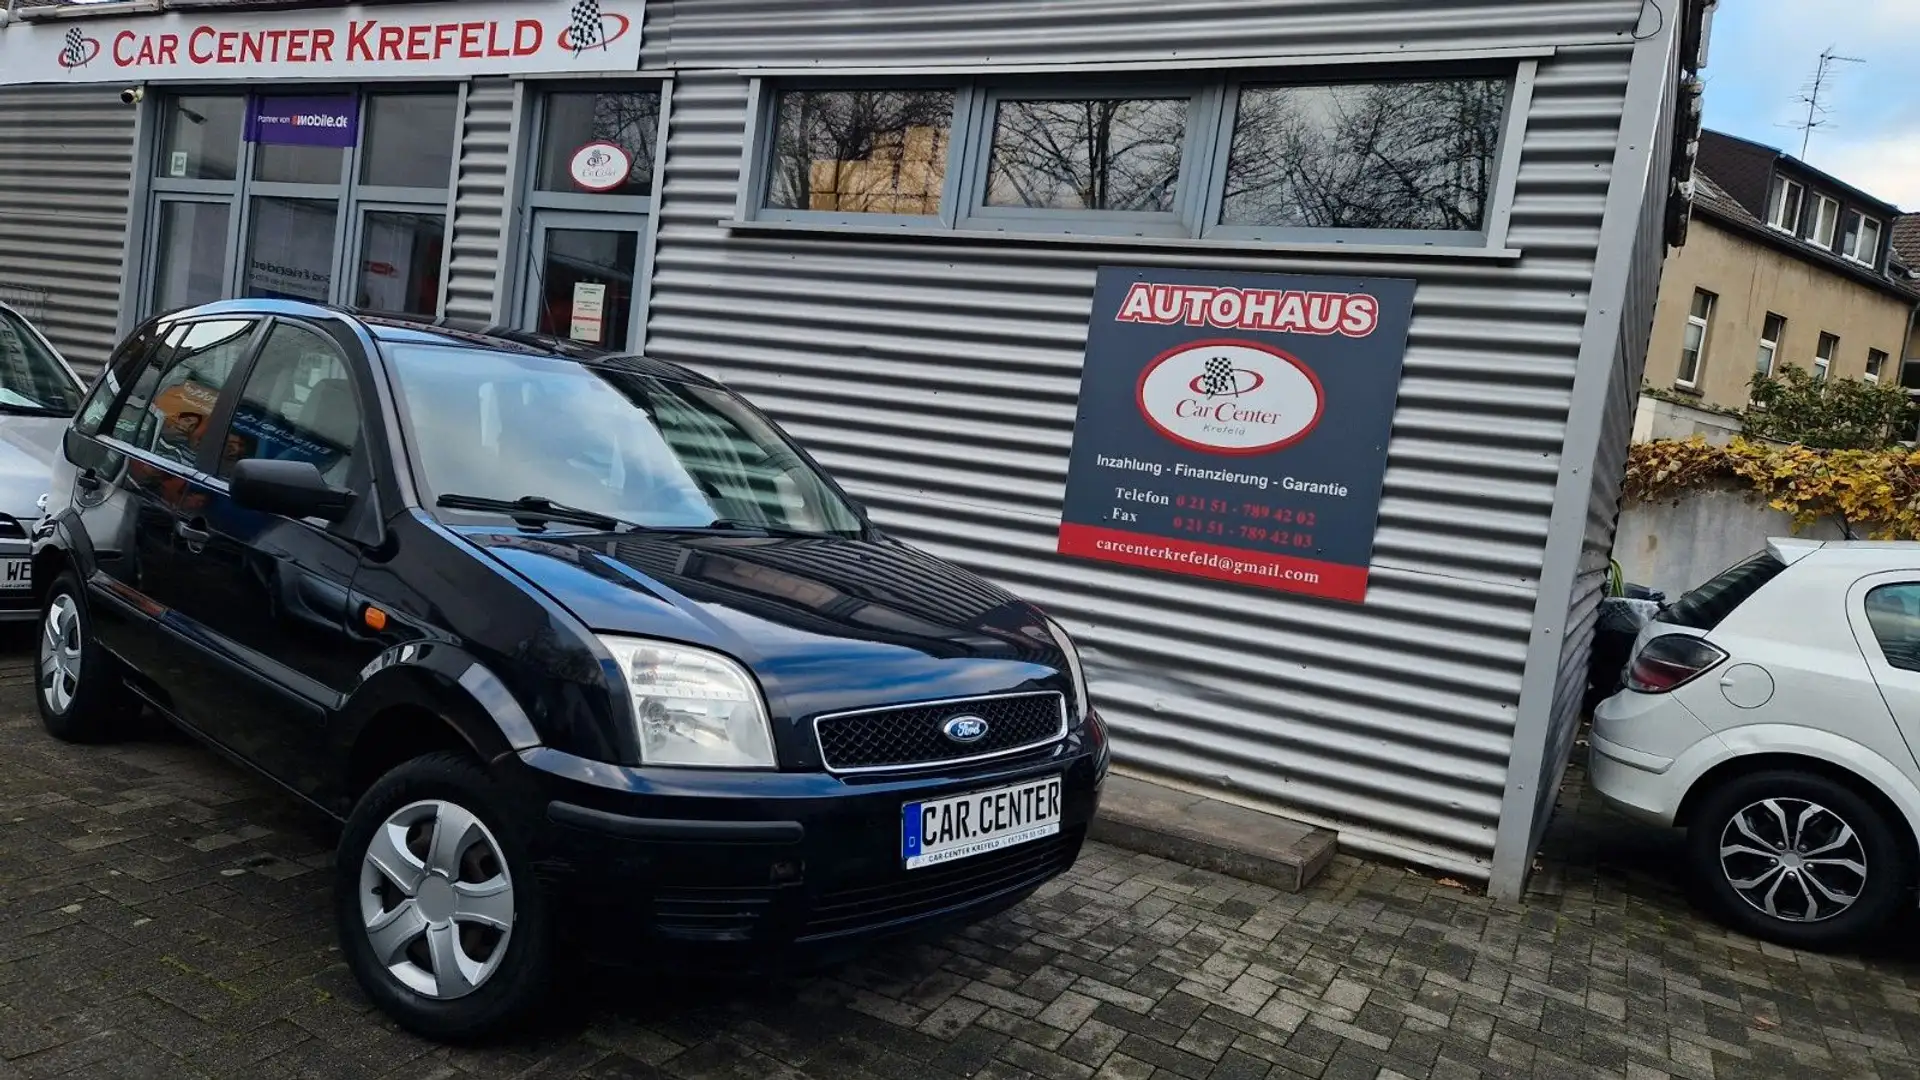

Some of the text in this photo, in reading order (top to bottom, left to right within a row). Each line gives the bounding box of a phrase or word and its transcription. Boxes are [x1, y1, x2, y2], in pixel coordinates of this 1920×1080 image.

[113, 19, 543, 67] CAR CENTER KREFELD
[1115, 282, 1379, 338] AUTOHAUS
[1175, 398, 1282, 424] Car Center
[1202, 423, 1246, 436] Krefeld
[1097, 454, 1162, 476] Inzahlung
[1175, 463, 1268, 490] Finanzierung
[1283, 477, 1348, 497] Garantie
[1115, 487, 1169, 505] Telefon
[1188, 496, 1205, 510] 21
[1210, 498, 1227, 513] 51
[1243, 504, 1269, 518] 789
[1273, 508, 1293, 522] 42
[1112, 508, 1138, 522] Fax
[1207, 521, 1223, 535] 51
[1240, 526, 1267, 540] 789
[1270, 530, 1289, 544] 42
[1096, 538, 1320, 584] carcenterkrefeld@gmail.com
[956, 721, 981, 736] Ford
[922, 781, 1060, 847] CAR.CENTER
